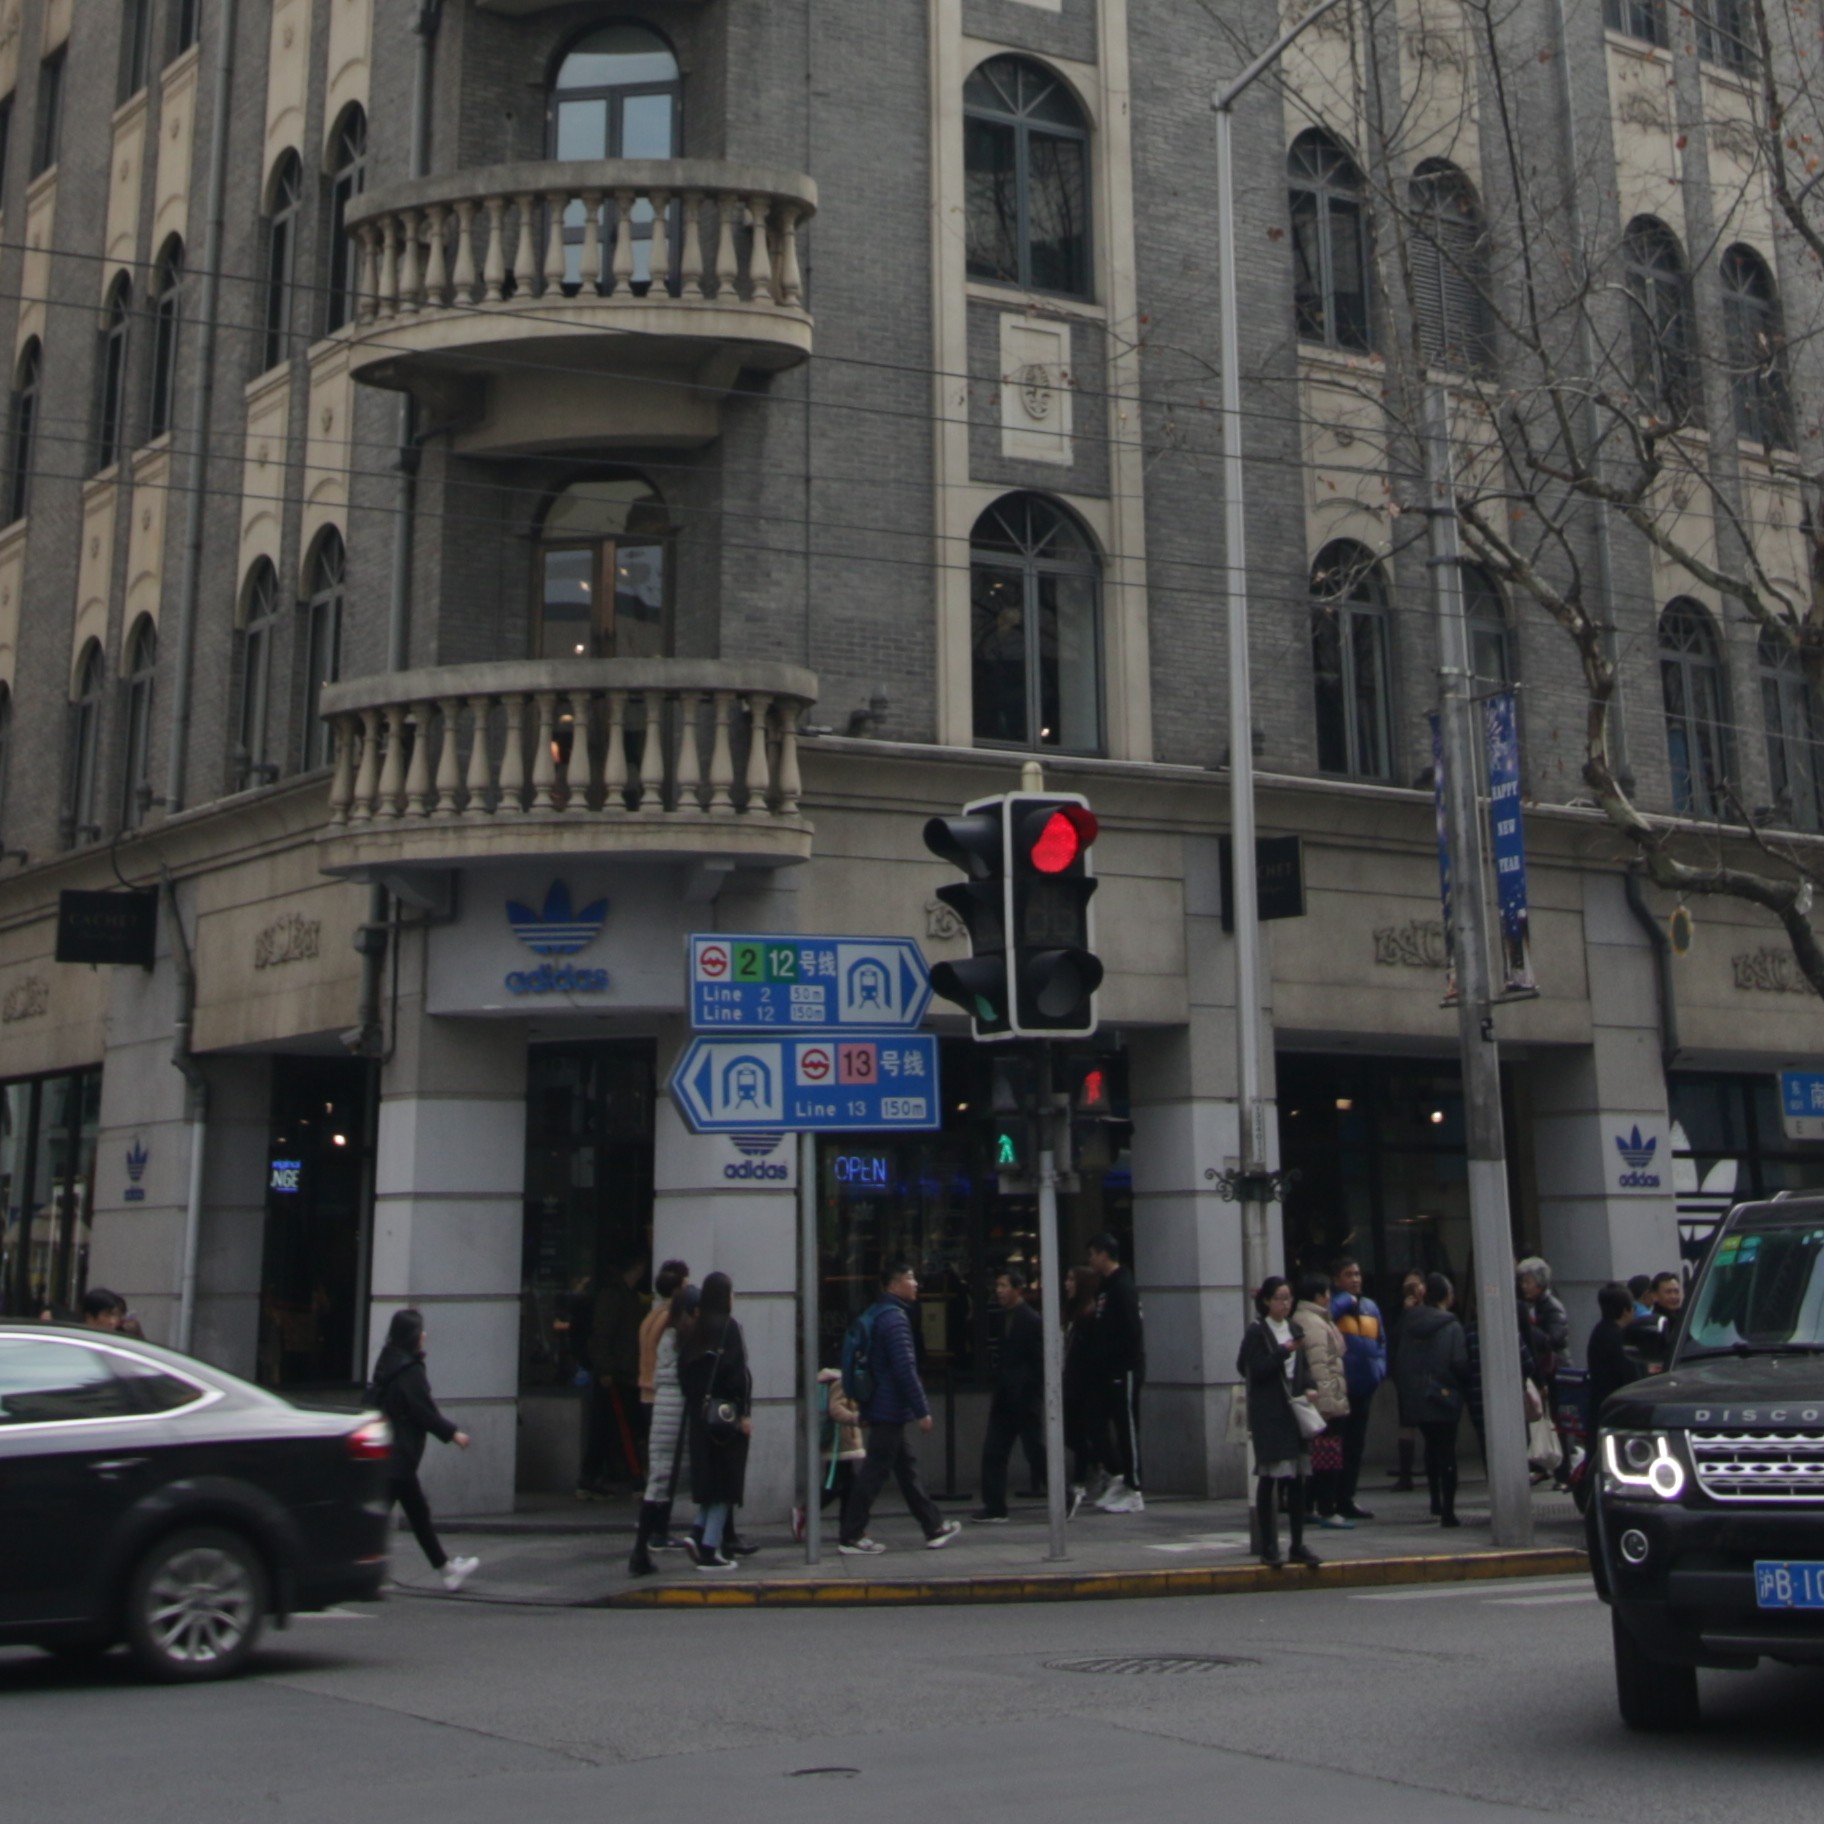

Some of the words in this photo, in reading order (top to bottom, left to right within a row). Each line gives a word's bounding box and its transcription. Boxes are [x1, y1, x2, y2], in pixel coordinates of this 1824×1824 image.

[1492, 780, 1518, 801] HAPPY
[1497, 818, 1516, 836] NEW
[1499, 855, 1520, 873] YEAR
[739, 948, 757, 976] 2
[769, 949, 795, 977] 12
[799, 950, 837, 977] 号线
[504, 963, 609, 994] adidas
[703, 985, 742, 1002] Line
[761, 987, 771, 1002] 2
[793, 987, 823, 1001] 50m
[703, 1004, 742, 1021] Line
[757, 1006, 774, 1021] 12
[792, 1006, 824, 1020] 150m
[843, 1050, 872, 1077] 13
[880, 1049, 925, 1077] 号线
[796, 1101, 836, 1117] Line
[847, 1101, 866, 1117] 13
[884, 1101, 924, 1116] 150m
[724, 1160, 789, 1180] adidas
[834, 1156, 886, 1182] OPEN
[1619, 1171, 1660, 1188] adidas
